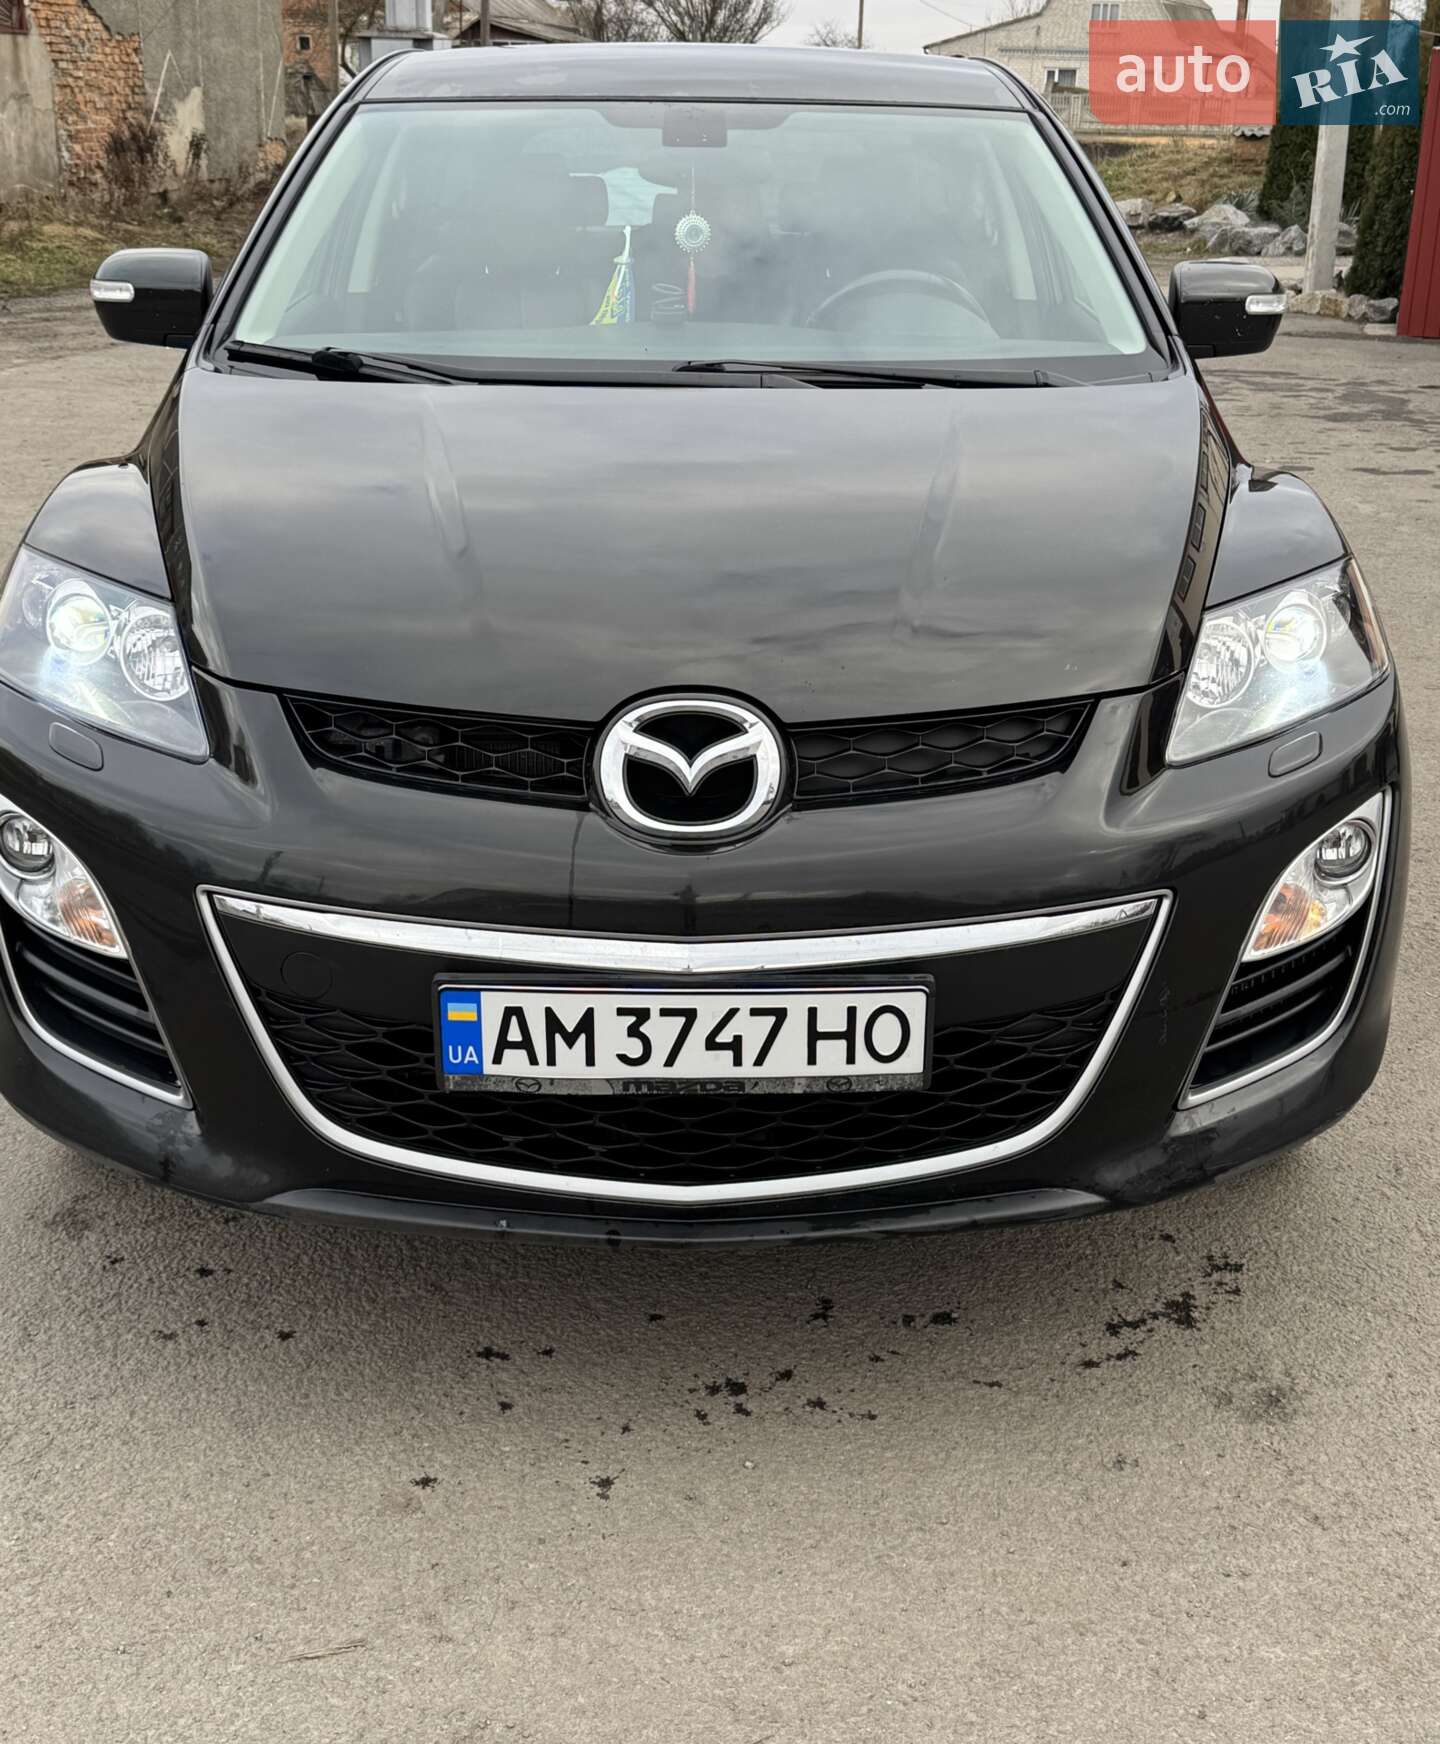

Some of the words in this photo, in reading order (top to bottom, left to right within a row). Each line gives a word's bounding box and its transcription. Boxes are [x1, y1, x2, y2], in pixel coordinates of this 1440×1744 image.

[448, 1045, 479, 1064] UA
[491, 1006, 597, 1067] AM
[615, 1006, 788, 1067] 3747
[806, 1004, 912, 1065] HO
